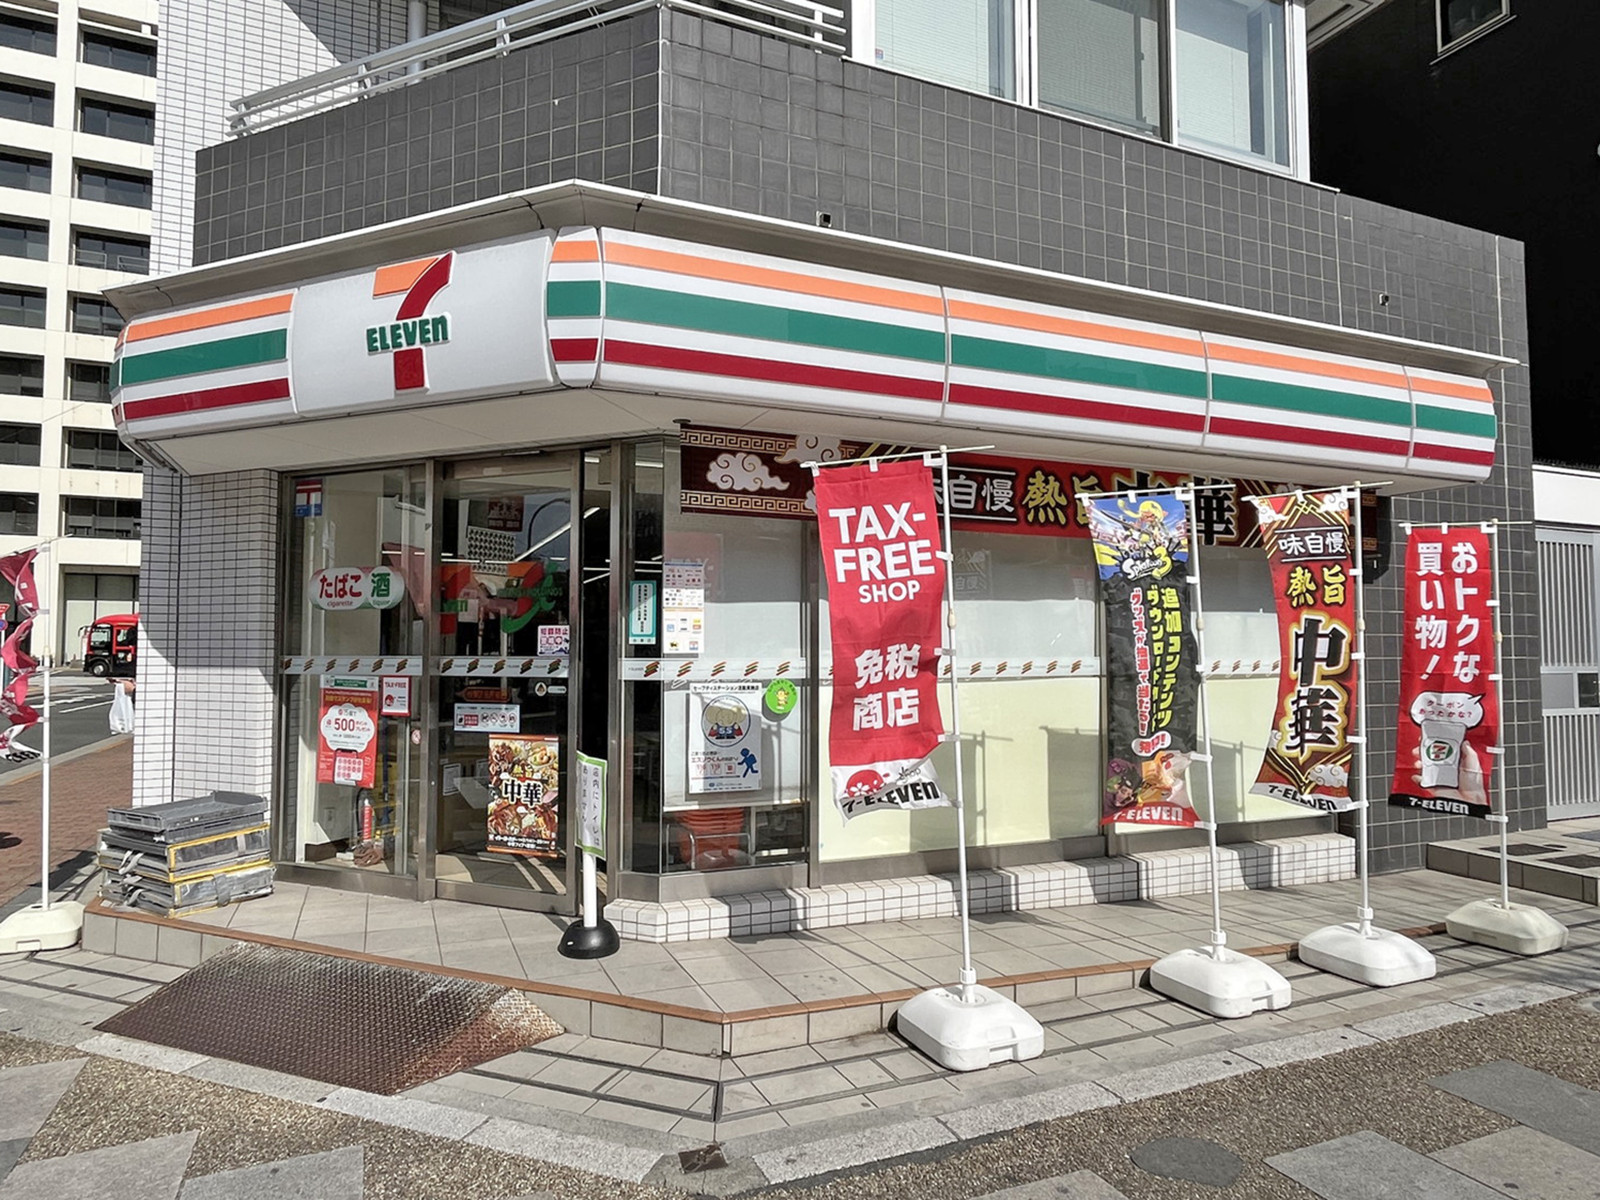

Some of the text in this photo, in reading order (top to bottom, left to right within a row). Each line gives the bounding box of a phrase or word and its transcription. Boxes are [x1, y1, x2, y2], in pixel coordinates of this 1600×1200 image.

[828, 502, 926, 544] TAX-
[1277, 531, 1346, 556] 味自慢
[834, 540, 936, 583] FREE
[1152, 545, 1173, 580] 3
[319, 572, 391, 599] たばこ 酒
[859, 580, 921, 604] SHOP
[1287, 564, 1347, 608] 熱旨
[1414, 542, 1449, 681] 買い物!
[1451, 542, 1481, 683] おトクな
[854, 643, 921, 689] 免税
[1285, 617, 1348, 758] 中華
[1427, 700, 1464, 709] クーポン
[334, 718, 356, 732] 500
[853, 688, 919, 731] 商店
[504, 779, 542, 807] 中華
